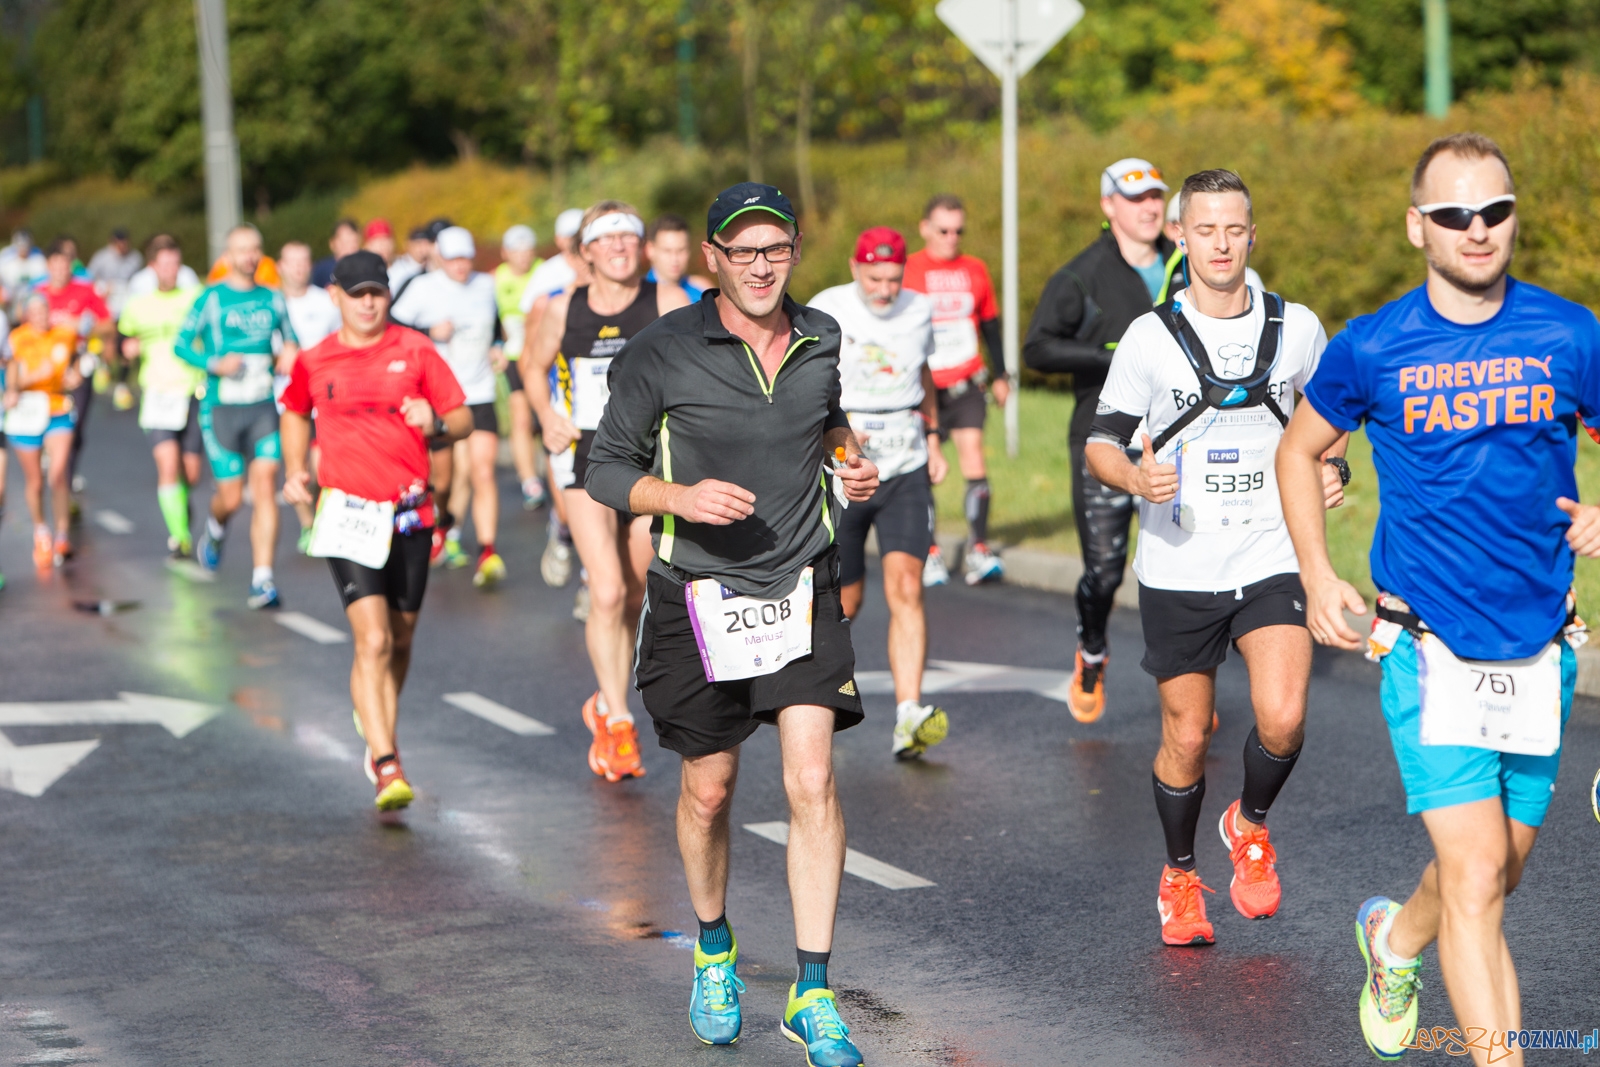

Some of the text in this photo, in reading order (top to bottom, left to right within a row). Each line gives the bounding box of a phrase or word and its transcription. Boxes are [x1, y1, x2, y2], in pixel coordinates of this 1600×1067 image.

[1399, 357, 1523, 393] FOREVER
[1230, 413, 1267, 423] DIETETYCZNY
[1404, 384, 1556, 434] FASTER
[1205, 471, 1264, 493] 5339
[724, 598, 792, 634] 2008
[744, 630, 784, 647] Mariusz
[1470, 669, 1516, 696] 761
